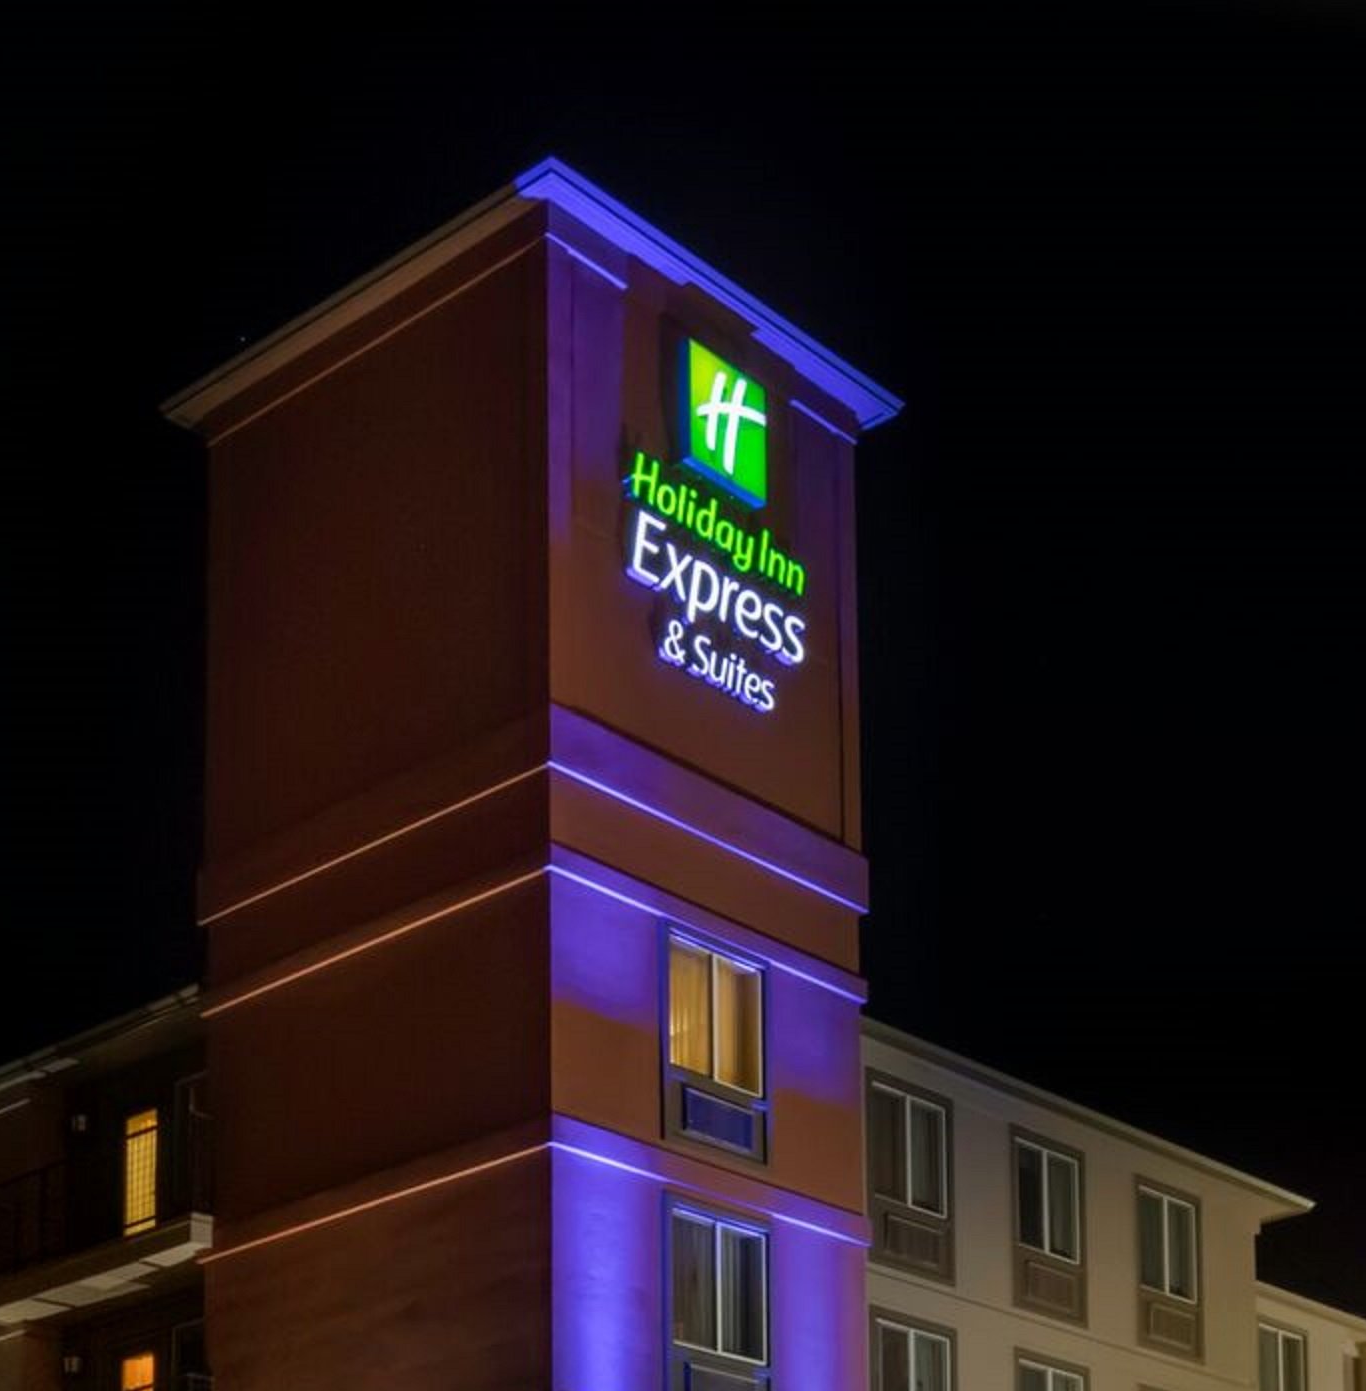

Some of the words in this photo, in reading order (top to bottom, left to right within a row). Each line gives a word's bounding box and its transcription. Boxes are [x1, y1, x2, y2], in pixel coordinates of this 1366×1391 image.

[632, 452, 756, 573] Holiday
[758, 529, 806, 597] Inn
[632, 509, 806, 664] Express
[663, 618, 687, 665] &
[692, 634, 776, 712] Suites
